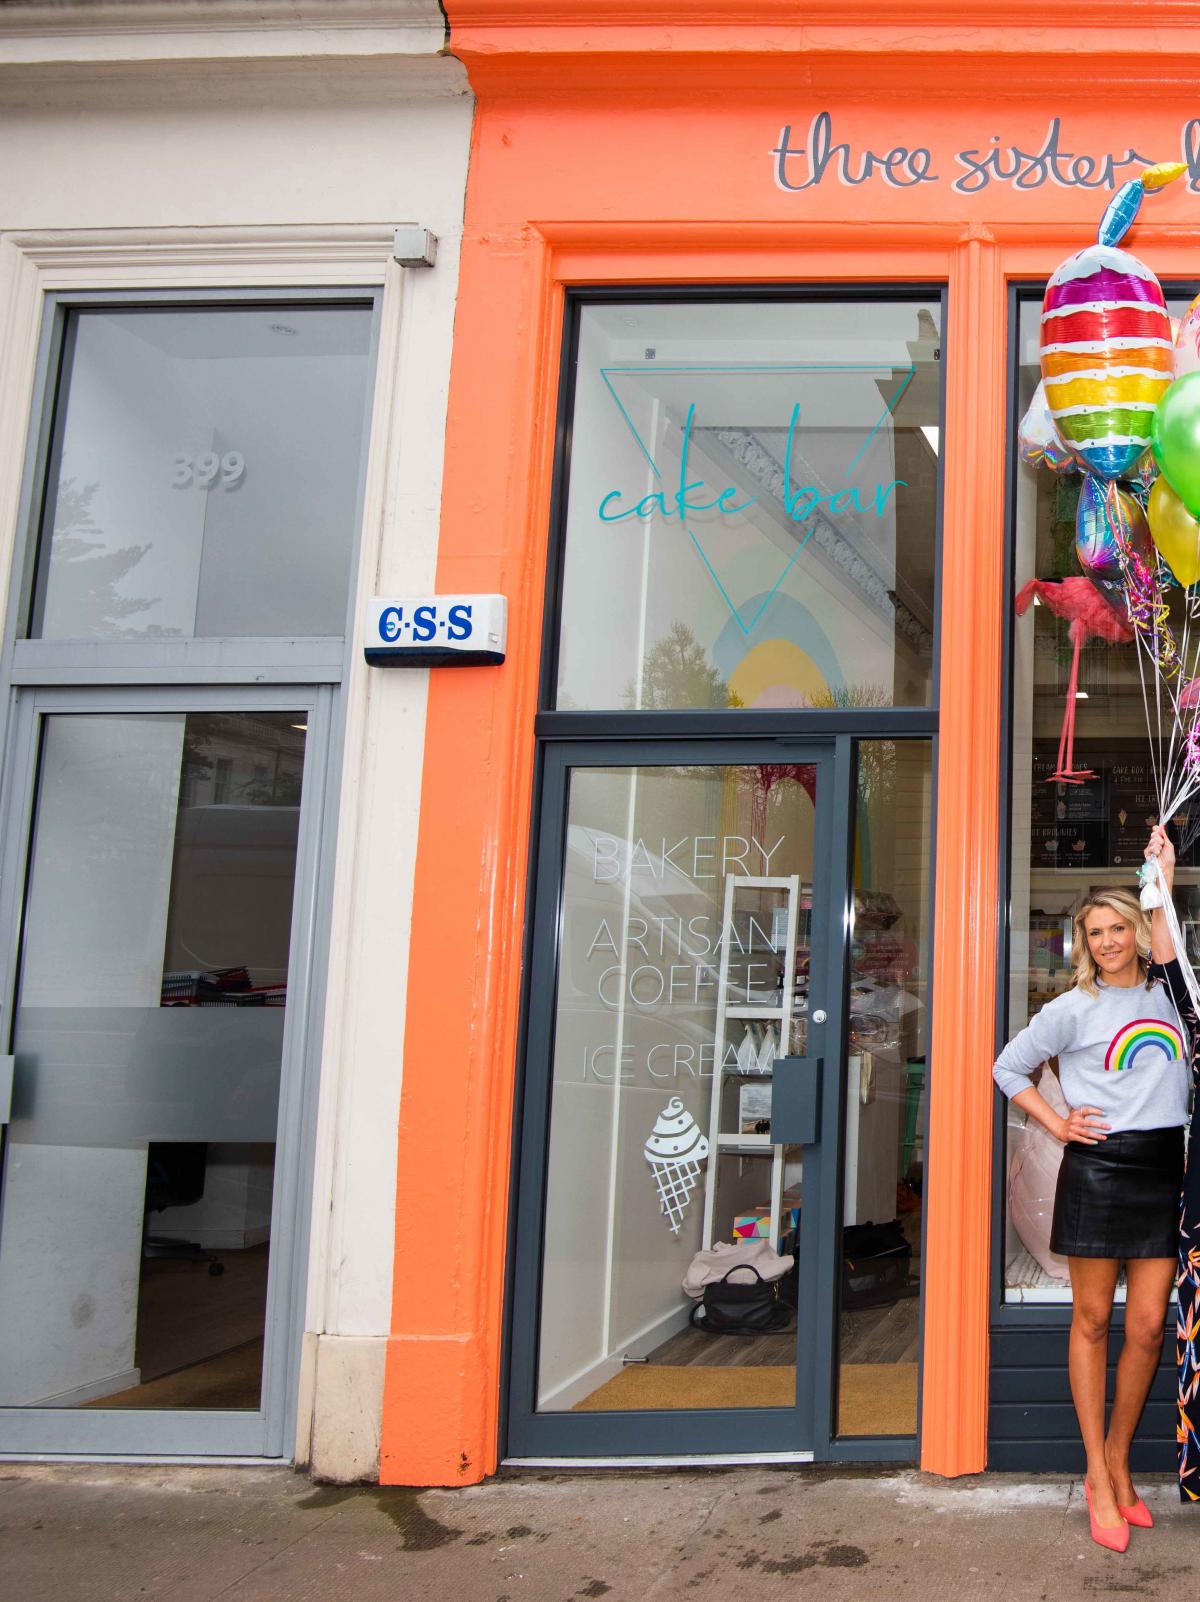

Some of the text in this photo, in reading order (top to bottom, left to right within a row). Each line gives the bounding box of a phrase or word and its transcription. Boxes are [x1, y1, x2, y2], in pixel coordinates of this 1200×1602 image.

[768, 111, 939, 193] three
[171, 450, 246, 486] 399
[598, 402, 909, 522] cake bar
[594, 835, 785, 881] BAKERY
[586, 916, 779, 962] ARTISAN
[598, 964, 768, 1006] COFFEE
[584, 1044, 781, 1082] ICE CREAM
